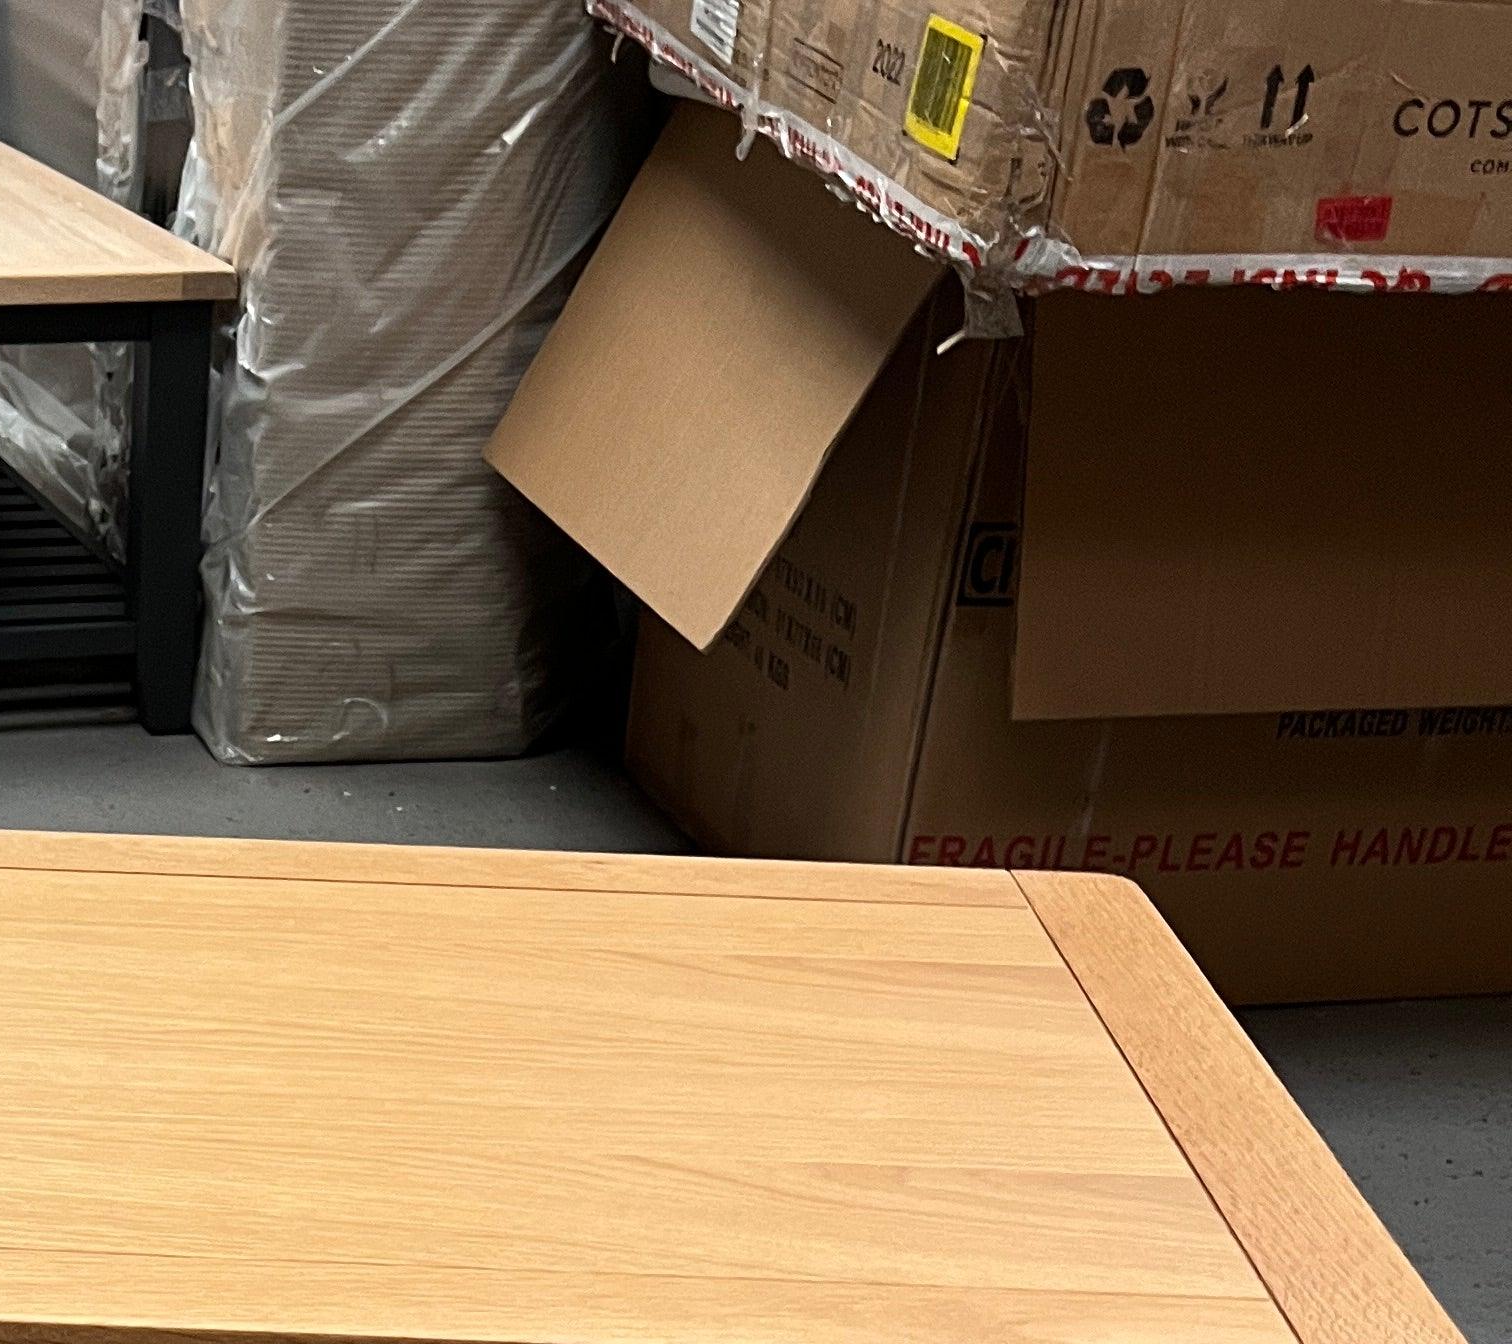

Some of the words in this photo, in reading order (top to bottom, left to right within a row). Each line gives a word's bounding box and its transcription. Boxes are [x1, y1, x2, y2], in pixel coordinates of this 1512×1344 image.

[1392, 97, 1512, 140] COTS
[1276, 710, 1410, 739] PACKAGED
[1330, 822, 1512, 868] HANDLE
